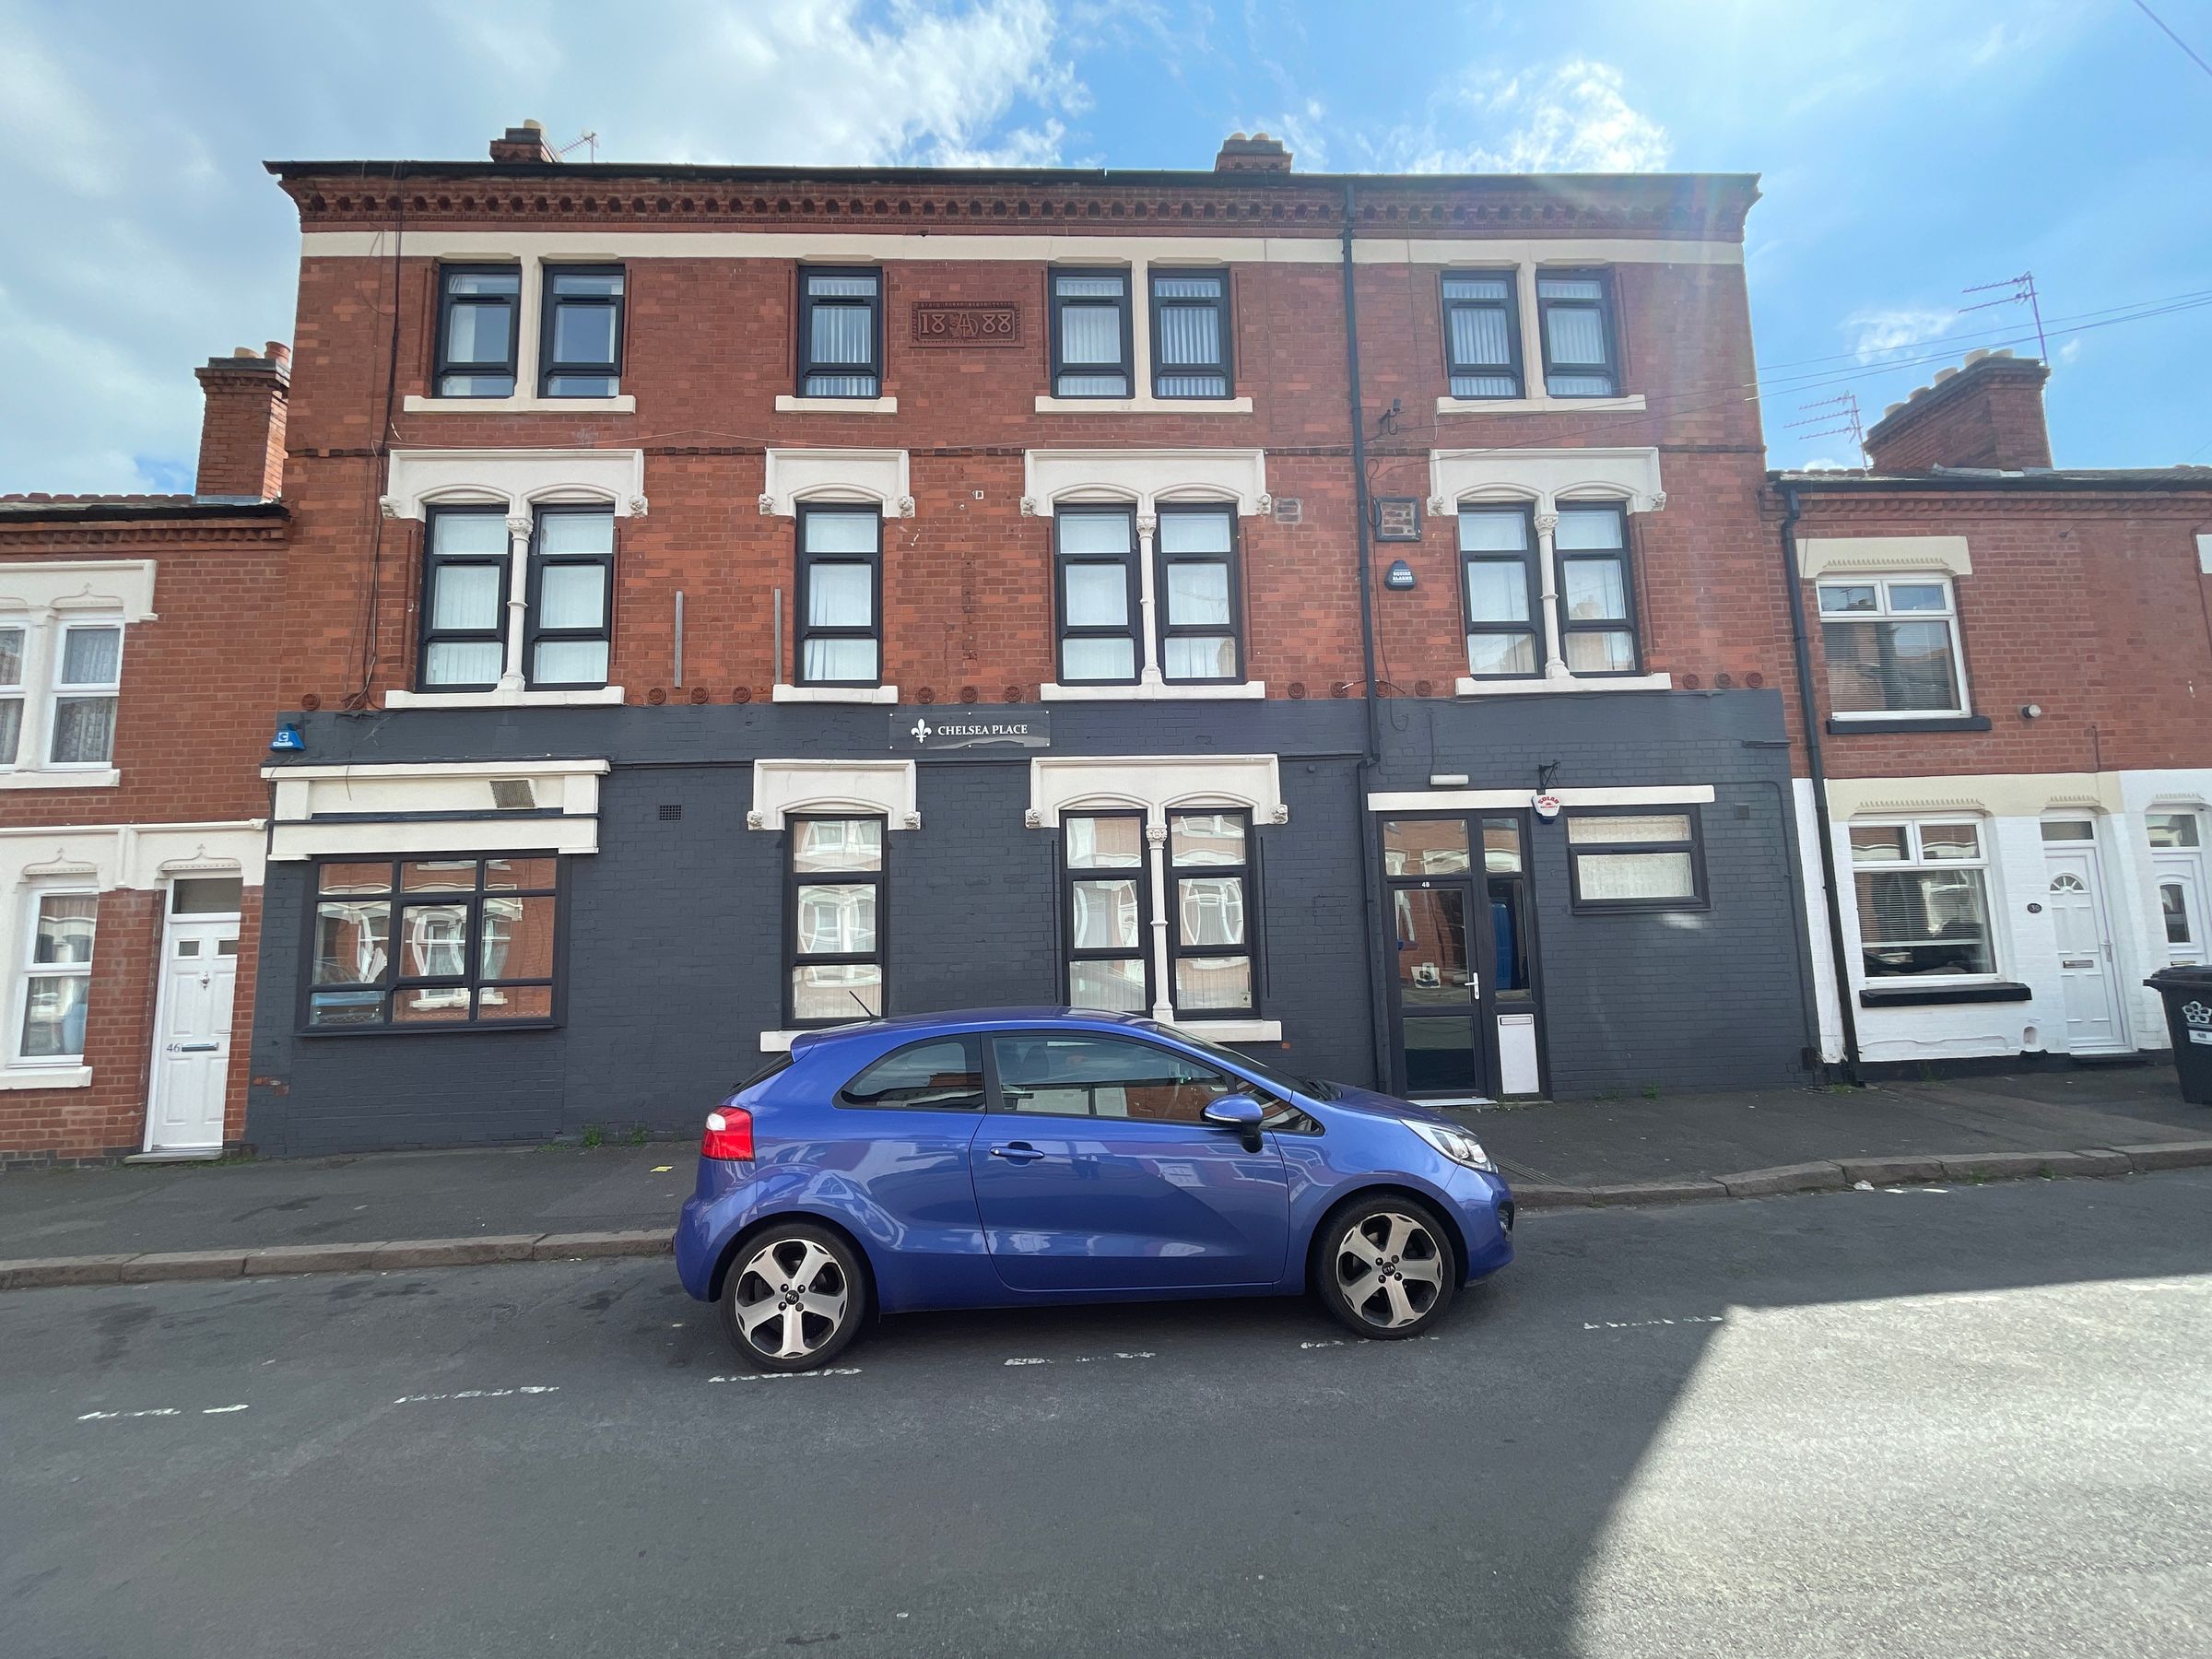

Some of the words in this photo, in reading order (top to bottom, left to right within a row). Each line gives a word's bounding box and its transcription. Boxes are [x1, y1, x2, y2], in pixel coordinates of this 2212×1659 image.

[922, 314, 946, 334] 18
[982, 314, 1011, 333] 88
[937, 725, 990, 735] CHELSEA
[992, 724, 1029, 735] PLACE
[166, 1042, 181, 1053] 46
[1382, 1265, 1395, 1274] KIA
[786, 1292, 798, 1302] KIA
